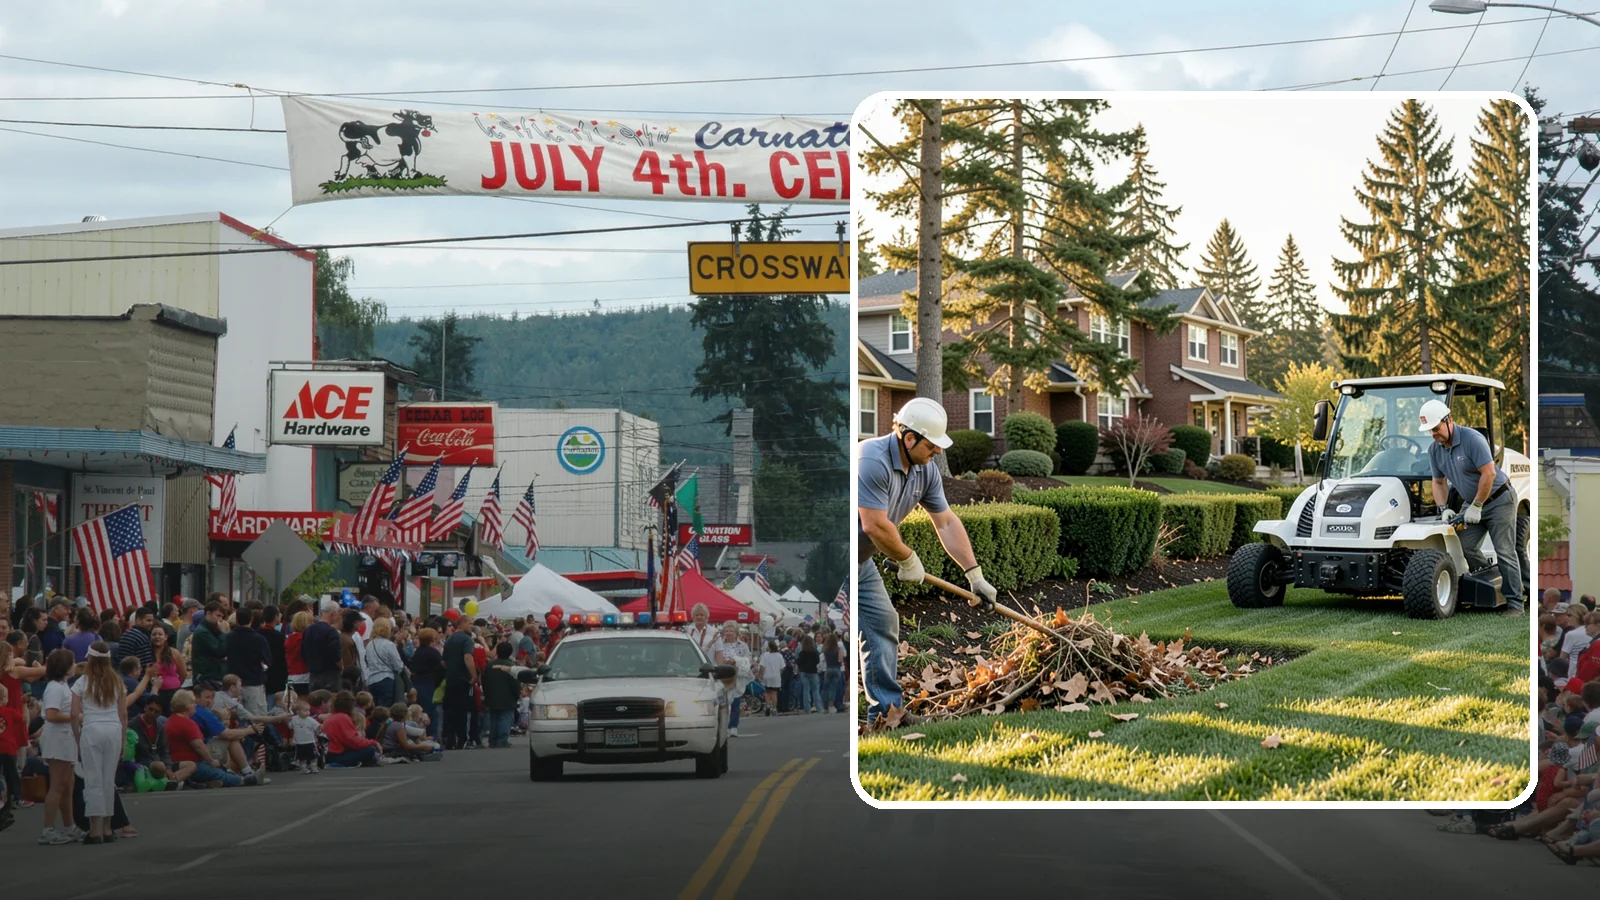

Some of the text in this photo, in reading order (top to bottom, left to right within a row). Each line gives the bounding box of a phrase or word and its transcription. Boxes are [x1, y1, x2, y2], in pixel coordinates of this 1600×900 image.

[695, 121, 850, 150] Carnat
[481, 141, 605, 192] JULY
[632, 150, 746, 198] 4th.
[697, 254, 850, 280] CROSSWA
[282, 379, 374, 420] ACE
[405, 409, 486, 422] CEDAR LOG
[283, 420, 371, 437] Hardware
[416, 428, 477, 447] Coca-Cola
[353, 467, 387, 480] Simpl
[83, 485, 155, 495] St. Vincent de Paul
[212, 515, 331, 535] HARDARE
[688, 526, 741, 535] CRNATION
[699, 535, 731, 543] GLASS
